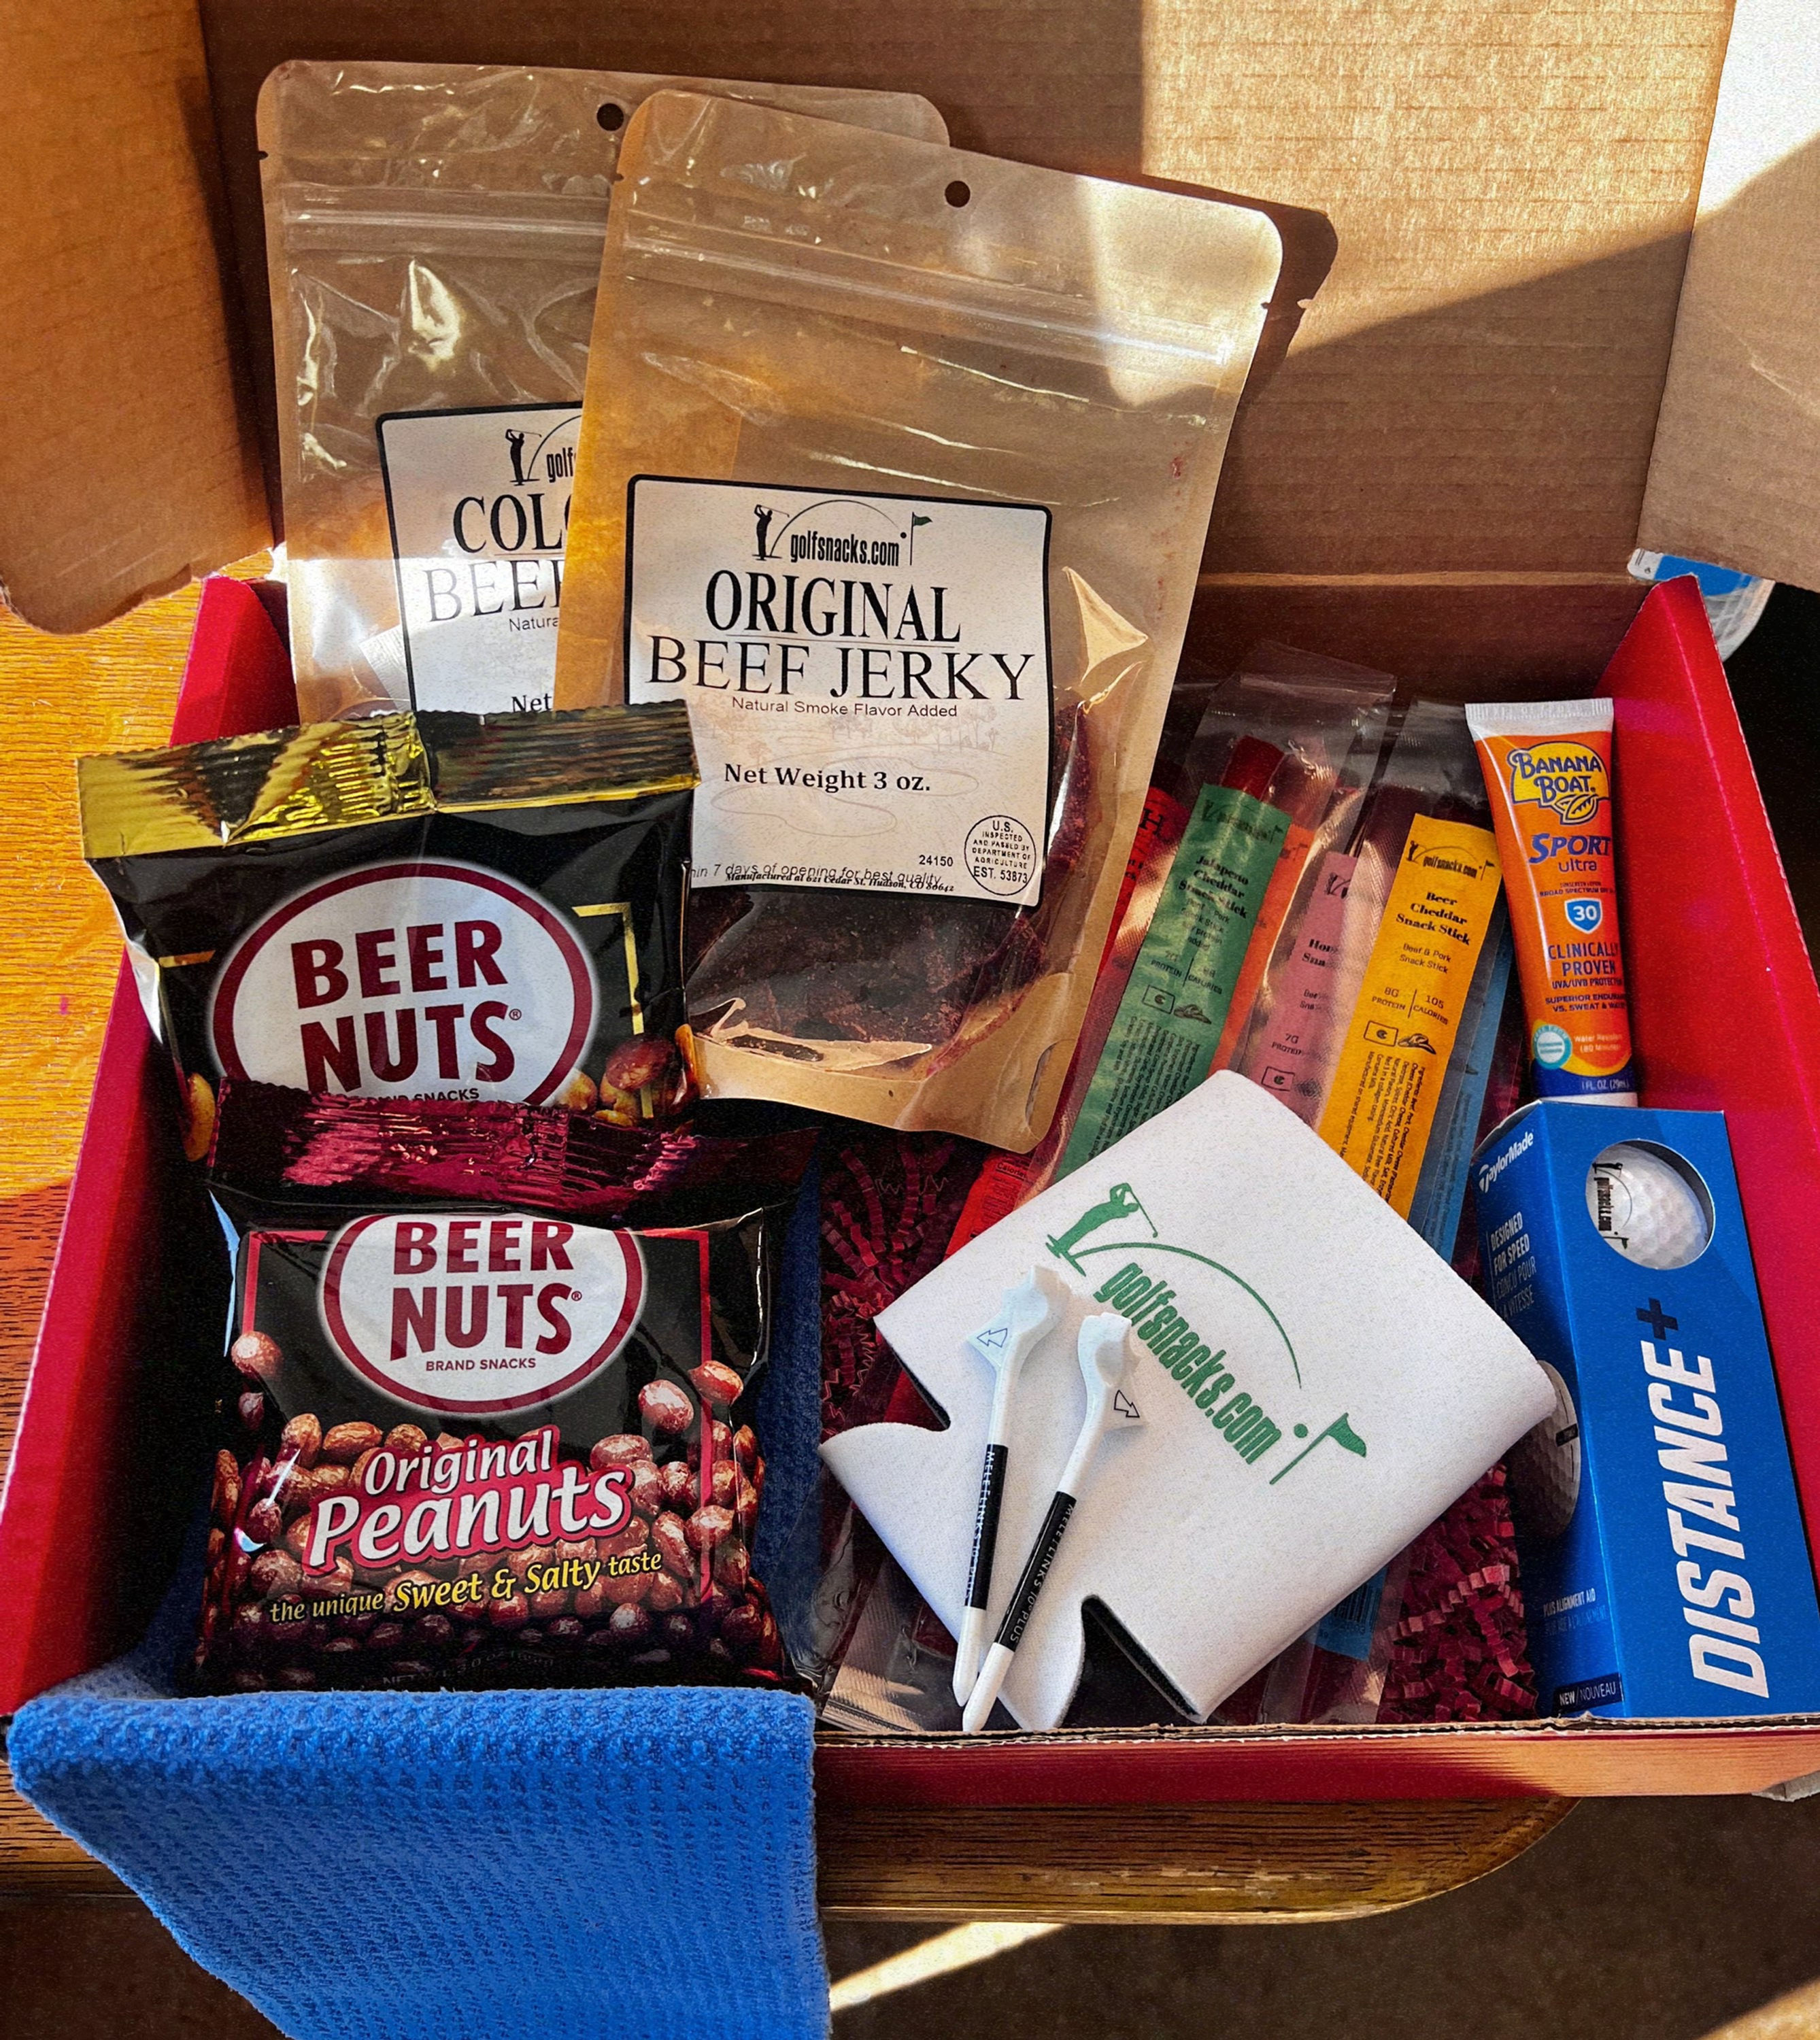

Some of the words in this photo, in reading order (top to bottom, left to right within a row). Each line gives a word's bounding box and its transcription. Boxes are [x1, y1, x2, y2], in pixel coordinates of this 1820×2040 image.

[546, 447, 577, 483] golf
[454, 492, 572, 554] COL
[790, 530, 900, 566] golfsnacks.com
[706, 569, 961, 643] ORIGINAL
[509, 617, 559, 632] Natura
[648, 635, 809, 694] BEEF
[830, 647, 1035, 700] JERKY
[511, 692, 552, 713] Net
[732, 696, 788, 713] Natural
[794, 702, 848, 715] Smoke
[854, 703, 903, 716] Flavor
[908, 705, 958, 717] Added
[1512, 752, 1602, 779] BANANA
[724, 764, 768, 785] Net
[775, 768, 866, 793] Weight
[873, 772, 887, 789] 3
[896, 775, 930, 792] oz.
[1533, 775, 1592, 802] BOAT
[982, 831, 1022, 842] INSPECTED
[993, 820, 1013, 833] U.S.
[972, 847, 1020, 858] DEPARTMENT
[992, 840, 1019, 849] PASSED
[1528, 833, 1611, 864] SPORT
[714, 864, 721, 877] 7
[763, 863, 777, 874] of
[781, 864, 837, 879] opening
[841, 866, 860, 878] for
[864, 868, 894, 880] best
[919, 854, 954, 867] 24150
[975, 857, 1028, 869] AGRICULTURE
[1558, 858, 1597, 872] ultra
[973, 866, 996, 879] EST.
[1000, 870, 1028, 883] 53873
[1194, 868, 1245, 898] Cheddar
[1426, 891, 1457, 906] Beer
[1410, 902, 1467, 926] Cheddar
[1572, 905, 1598, 921] 30
[1396, 913, 1436, 932] Snack
[1438, 924, 1471, 946] Stick
[291, 919, 508, 1009] BEER
[1151, 959, 1183, 978] PROTEIN
[1399, 954, 1426, 967] Snack
[1427, 960, 1449, 974] Stick
[1433, 950, 1451, 963] Pork
[1562, 959, 1616, 976] PROVEN
[1552, 979, 1588, 990] UVA/UVB
[1372, 996, 1406, 1010] PROTEIN
[1413, 1004, 1449, 1025] CALORIES
[1426, 995, 1445, 1010] 105
[1545, 994, 1591, 1004] SUPERIOR
[1569, 1003, 1600, 1012] SWEAT
[1479, 1130, 1534, 1193] TaylorMade
[1490, 1211, 1523, 1251] DESIGNED
[393, 1221, 575, 1275] BEER
[1494, 1251, 1508, 1276] FOR
[1508, 1233, 1531, 1265] SPEED
[1517, 1255, 1537, 1285] POUR
[426, 1359, 475, 1372] BRAND
[479, 1357, 537, 1370] SNACKS
[1092, 1262, 1282, 1465] golfsnacks.com
[365, 1430, 554, 1495] Original
[308, 1469, 627, 1568] Peanuts
[270, 1601, 310, 1623] the
[312, 1591, 385, 1619] unique
[394, 1574, 484, 1613] Sweet
[491, 1569, 517, 1599] &
[524, 1561, 601, 1594] Salty
[608, 1551, 663, 1576] taste
[1009, 1610, 1030, 1644] PLUS
